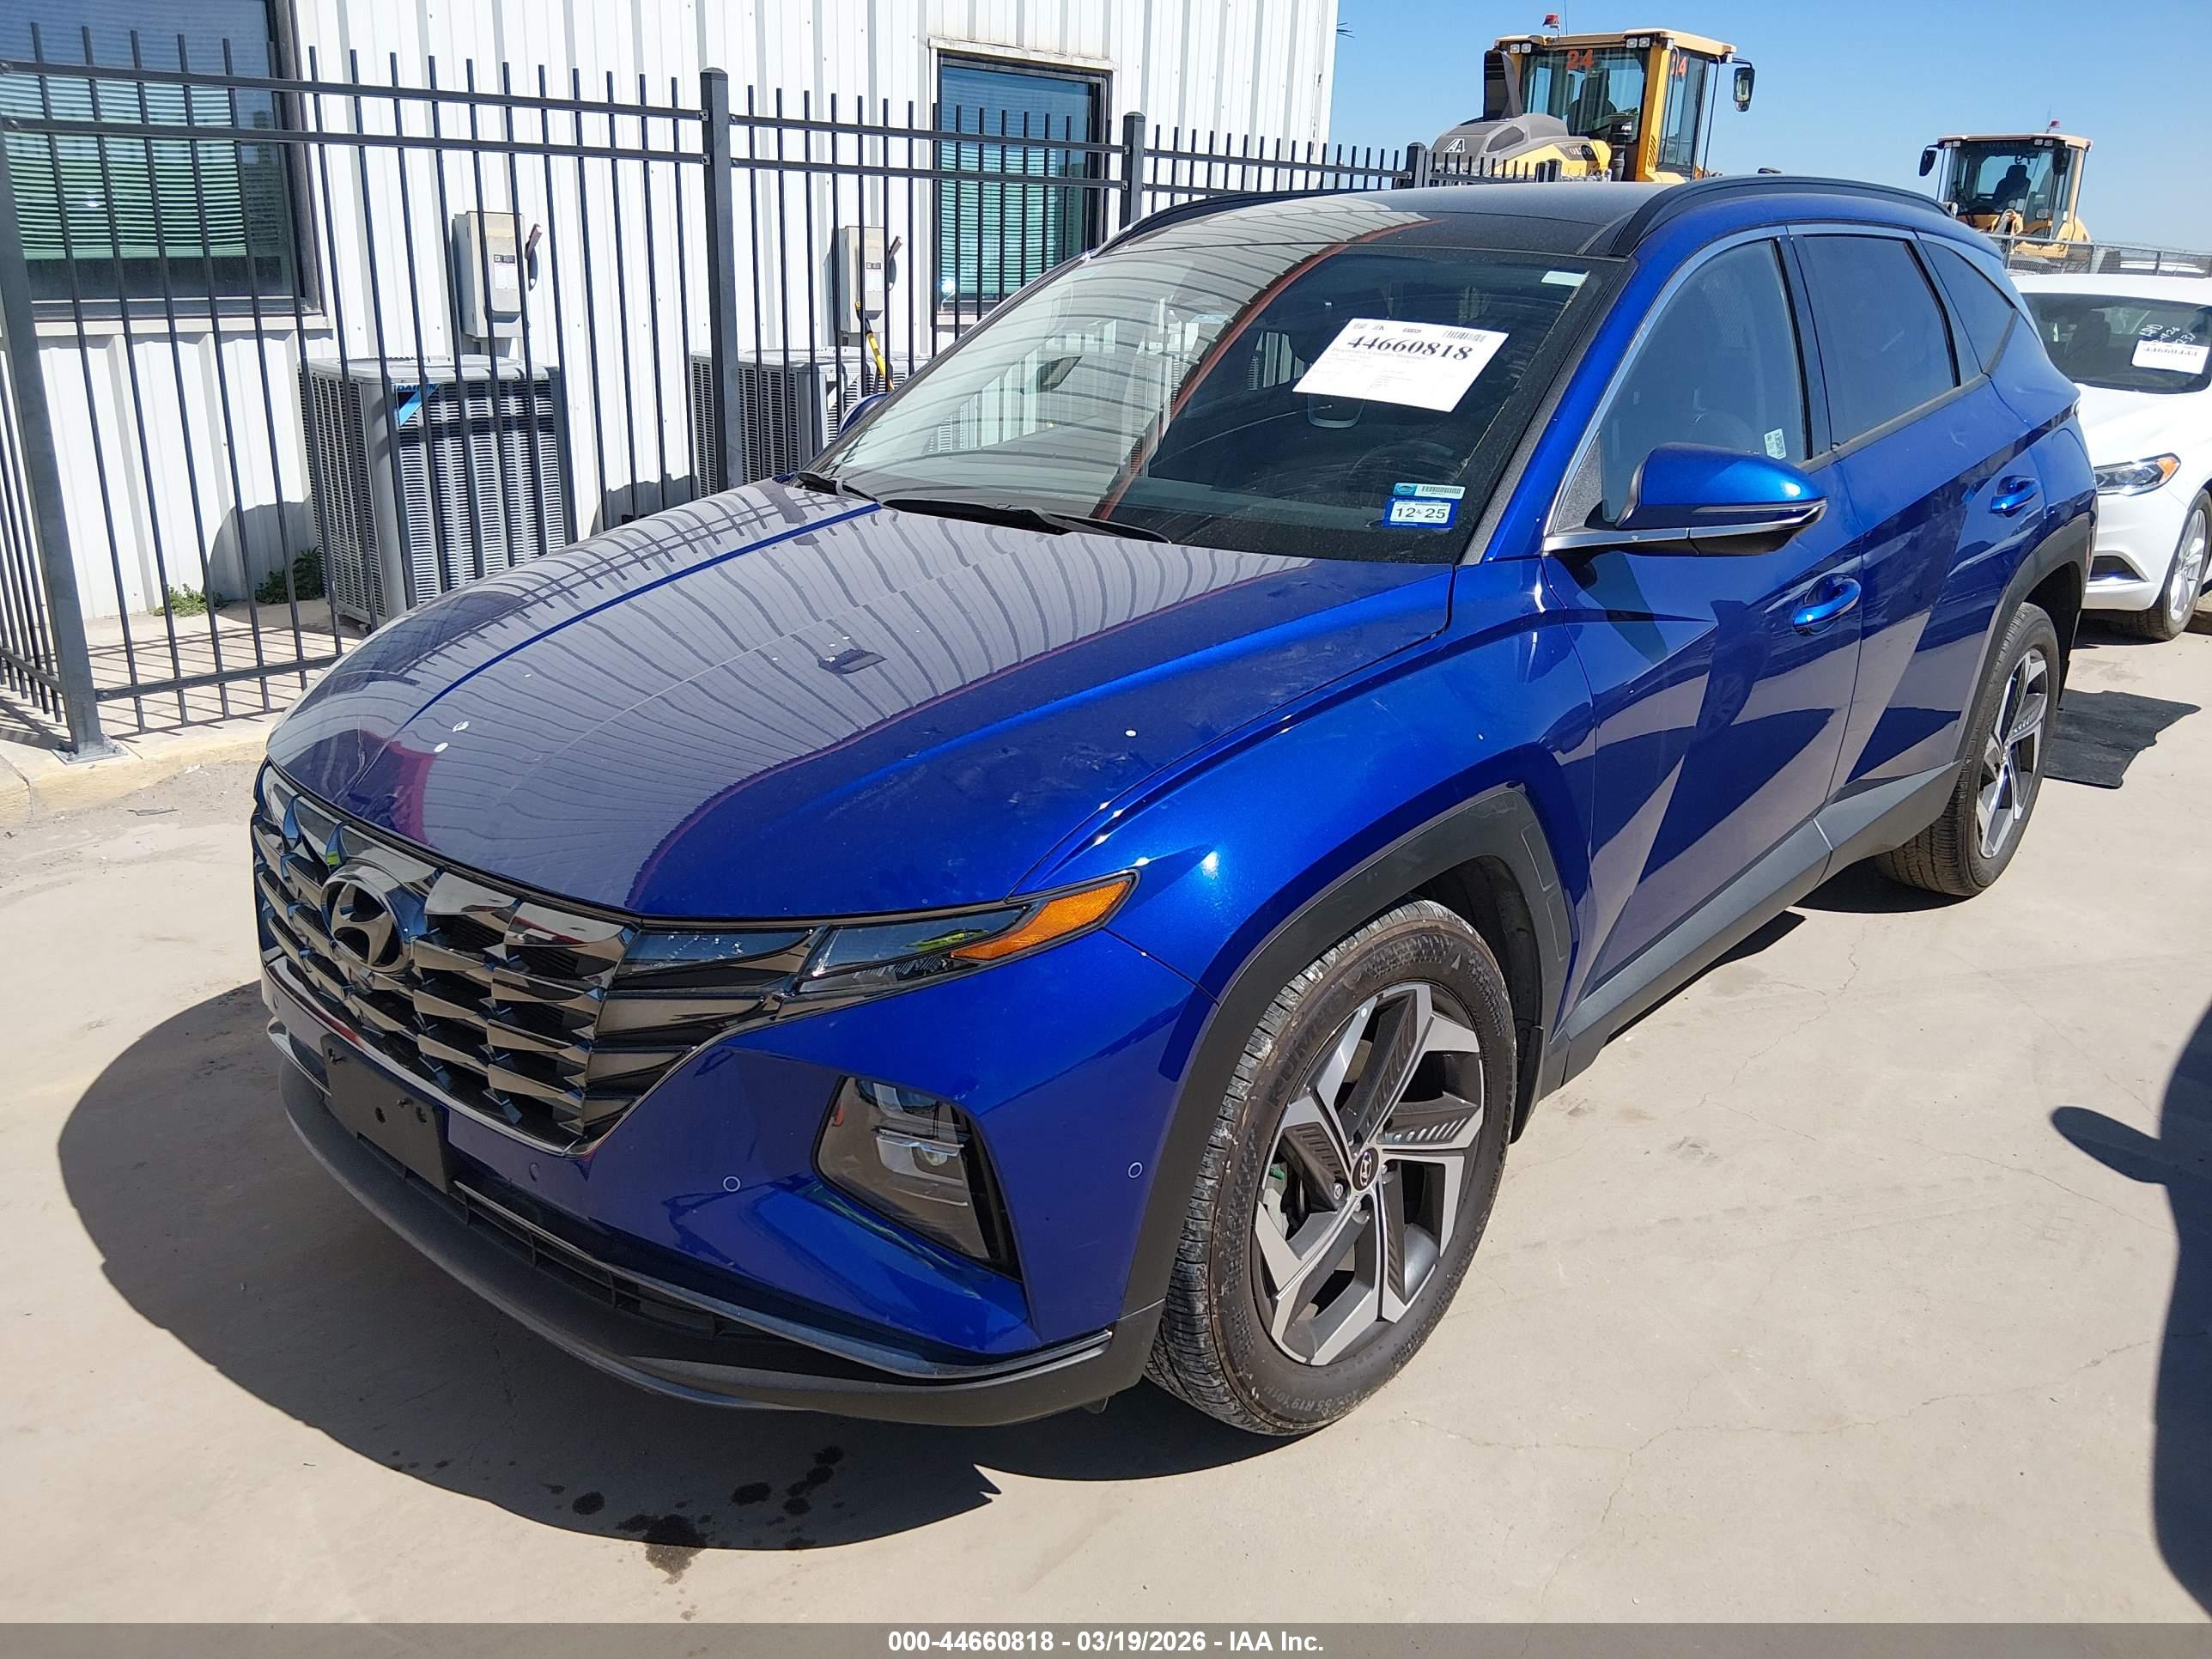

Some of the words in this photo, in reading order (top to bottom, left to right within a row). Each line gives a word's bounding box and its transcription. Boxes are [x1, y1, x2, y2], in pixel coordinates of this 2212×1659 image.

[1565, 49, 1595, 70] 24
[1347, 335, 1474, 362] 44660818
[1396, 507, 1416, 518] 12
[1425, 507, 1447, 519] 25
